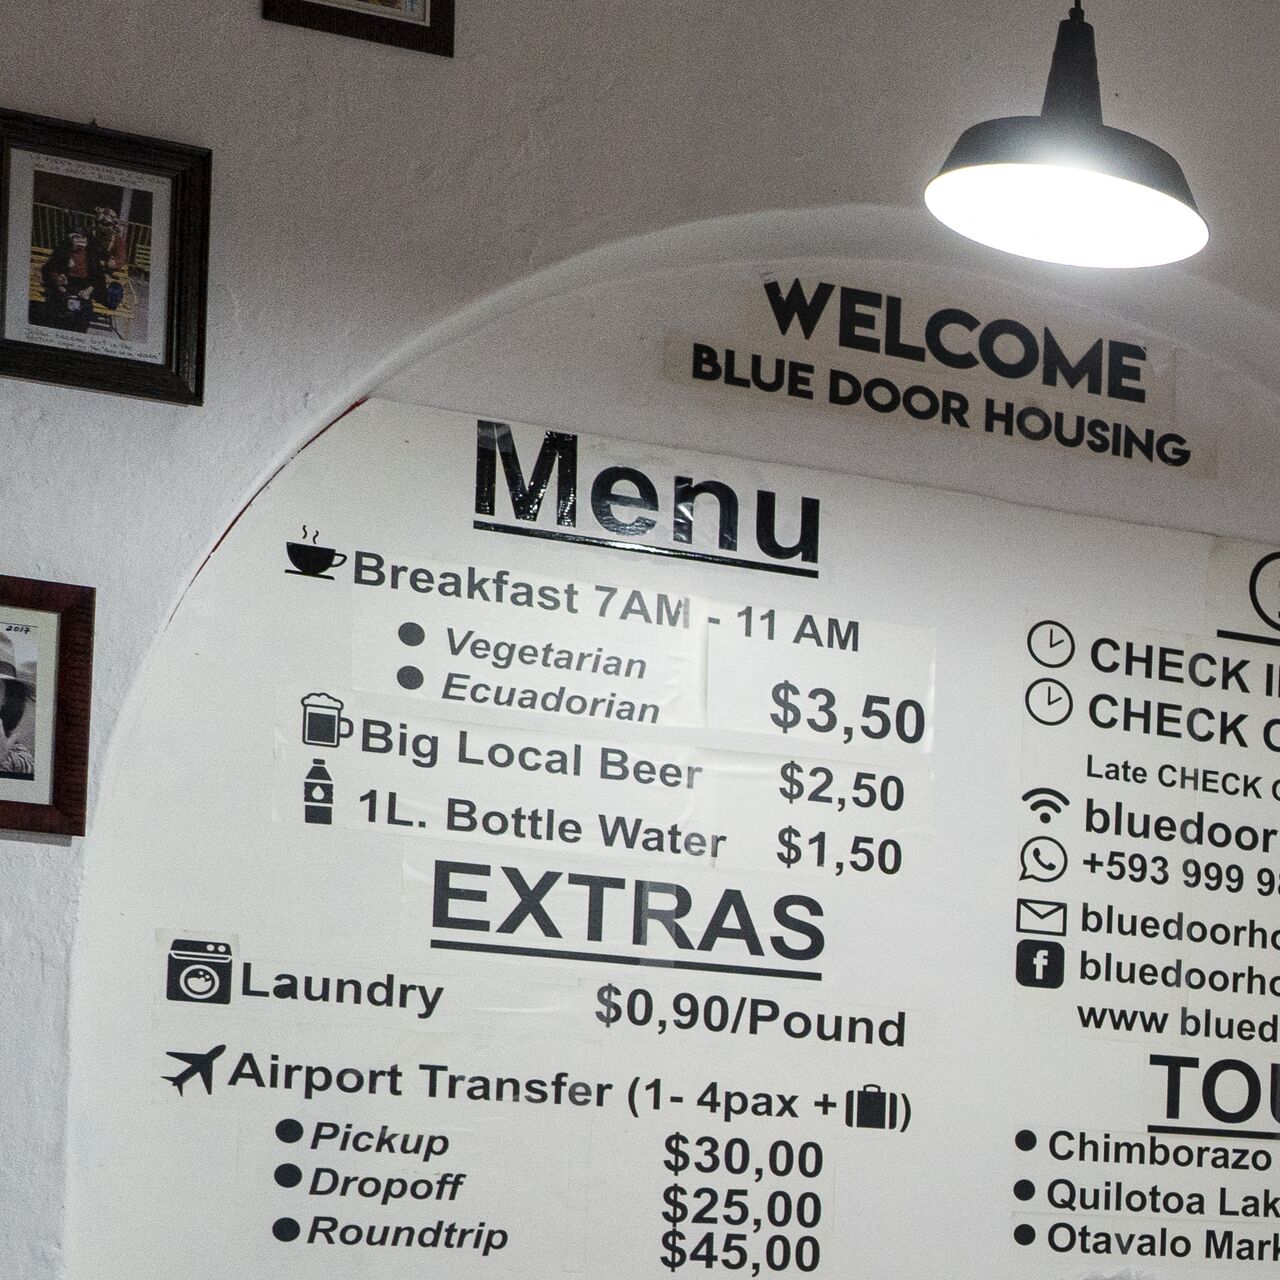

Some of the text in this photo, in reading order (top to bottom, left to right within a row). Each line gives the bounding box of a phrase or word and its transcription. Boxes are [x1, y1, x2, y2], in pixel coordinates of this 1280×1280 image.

[762, 277, 1148, 405] WELCOME
[691, 342, 1192, 468] BLUE DOOR HOUSING
[474, 418, 821, 564] Menu
[353, 550, 578, 614] Breakfast
[595, 585, 690, 630] 7AM
[737, 605, 776, 641] 11
[792, 614, 860, 652] AM
[446, 627, 646, 679] Vegetarian
[1090, 637, 1251, 694] CHECK
[441, 672, 659, 724] Ecuadorian
[770, 679, 926, 745] $3,50
[1088, 693, 1249, 749] CHECK
[361, 718, 905, 813] Big Local Beer $2,50
[1086, 753, 1148, 785] Late
[1157, 763, 1262, 800] CHECK
[359, 788, 903, 877] 1L. Bottle Water $1,50
[1085, 797, 1279, 854] bluedoor
[1082, 850, 1170, 886] +593
[1181, 858, 1245, 894] 999
[431, 859, 826, 962] EXTRAS
[241, 961, 906, 1048] Laundry $0,90/Pound
[227, 1052, 403, 1100] Airport
[418, 1063, 614, 1108] Transfer
[696, 1081, 799, 1123] 4pax
[309, 1121, 824, 1183] Pickup $30,00
[1048, 1129, 1273, 1172] Chimborazo
[308, 1167, 823, 1230] Dropoff $25,00
[1046, 1178, 1205, 1216] Quilotoa
[306, 1215, 821, 1276] Roundtrip $45,00
[1047, 1221, 1192, 1258] Otavalo
